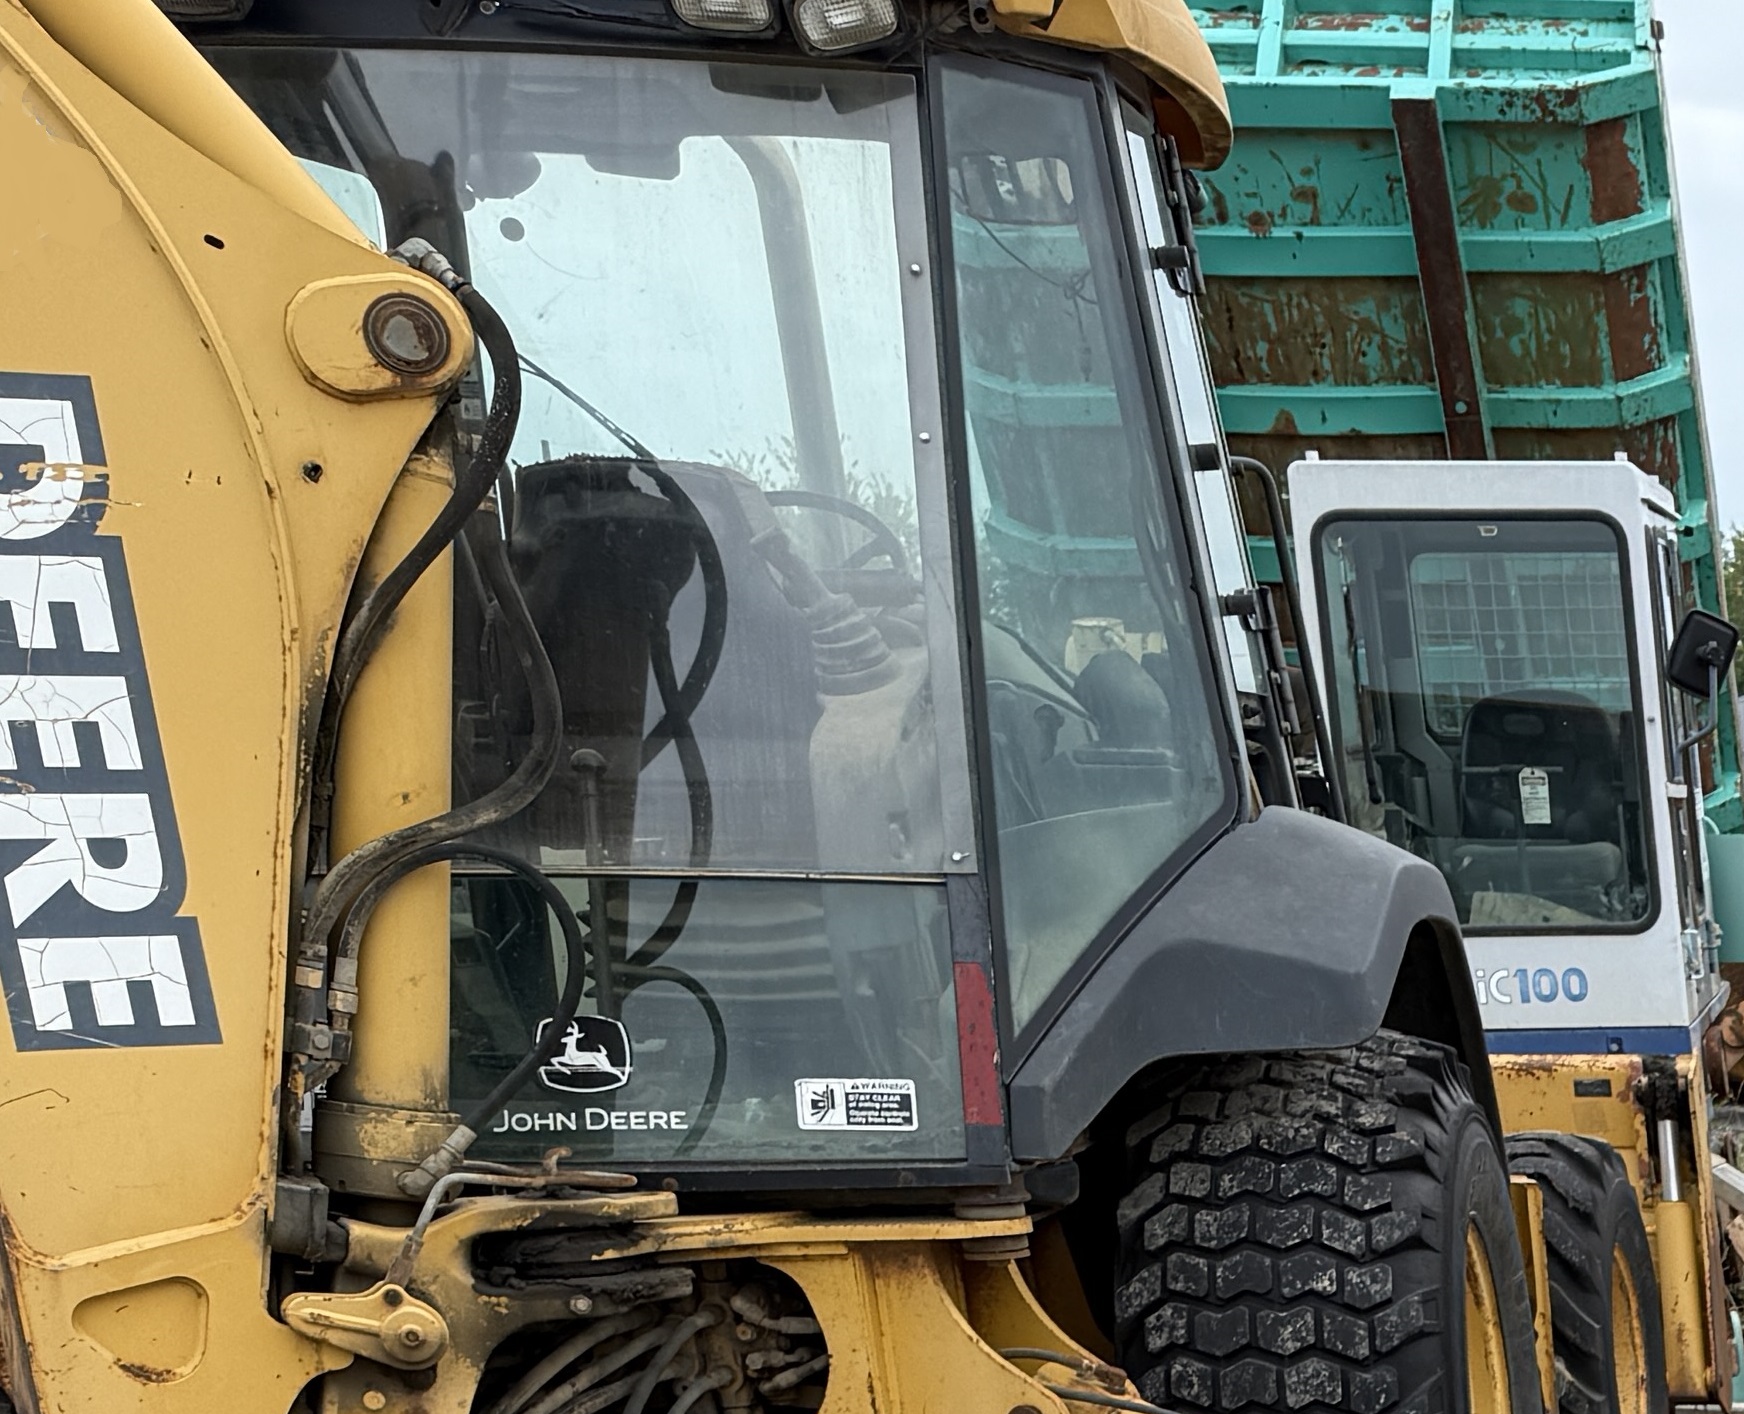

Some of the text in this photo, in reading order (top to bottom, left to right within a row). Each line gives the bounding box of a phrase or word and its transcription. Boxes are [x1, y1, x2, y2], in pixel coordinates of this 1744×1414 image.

[0, 398, 197, 1031] DEERE
[493, 1108, 689, 1132] JOHN DEERE
